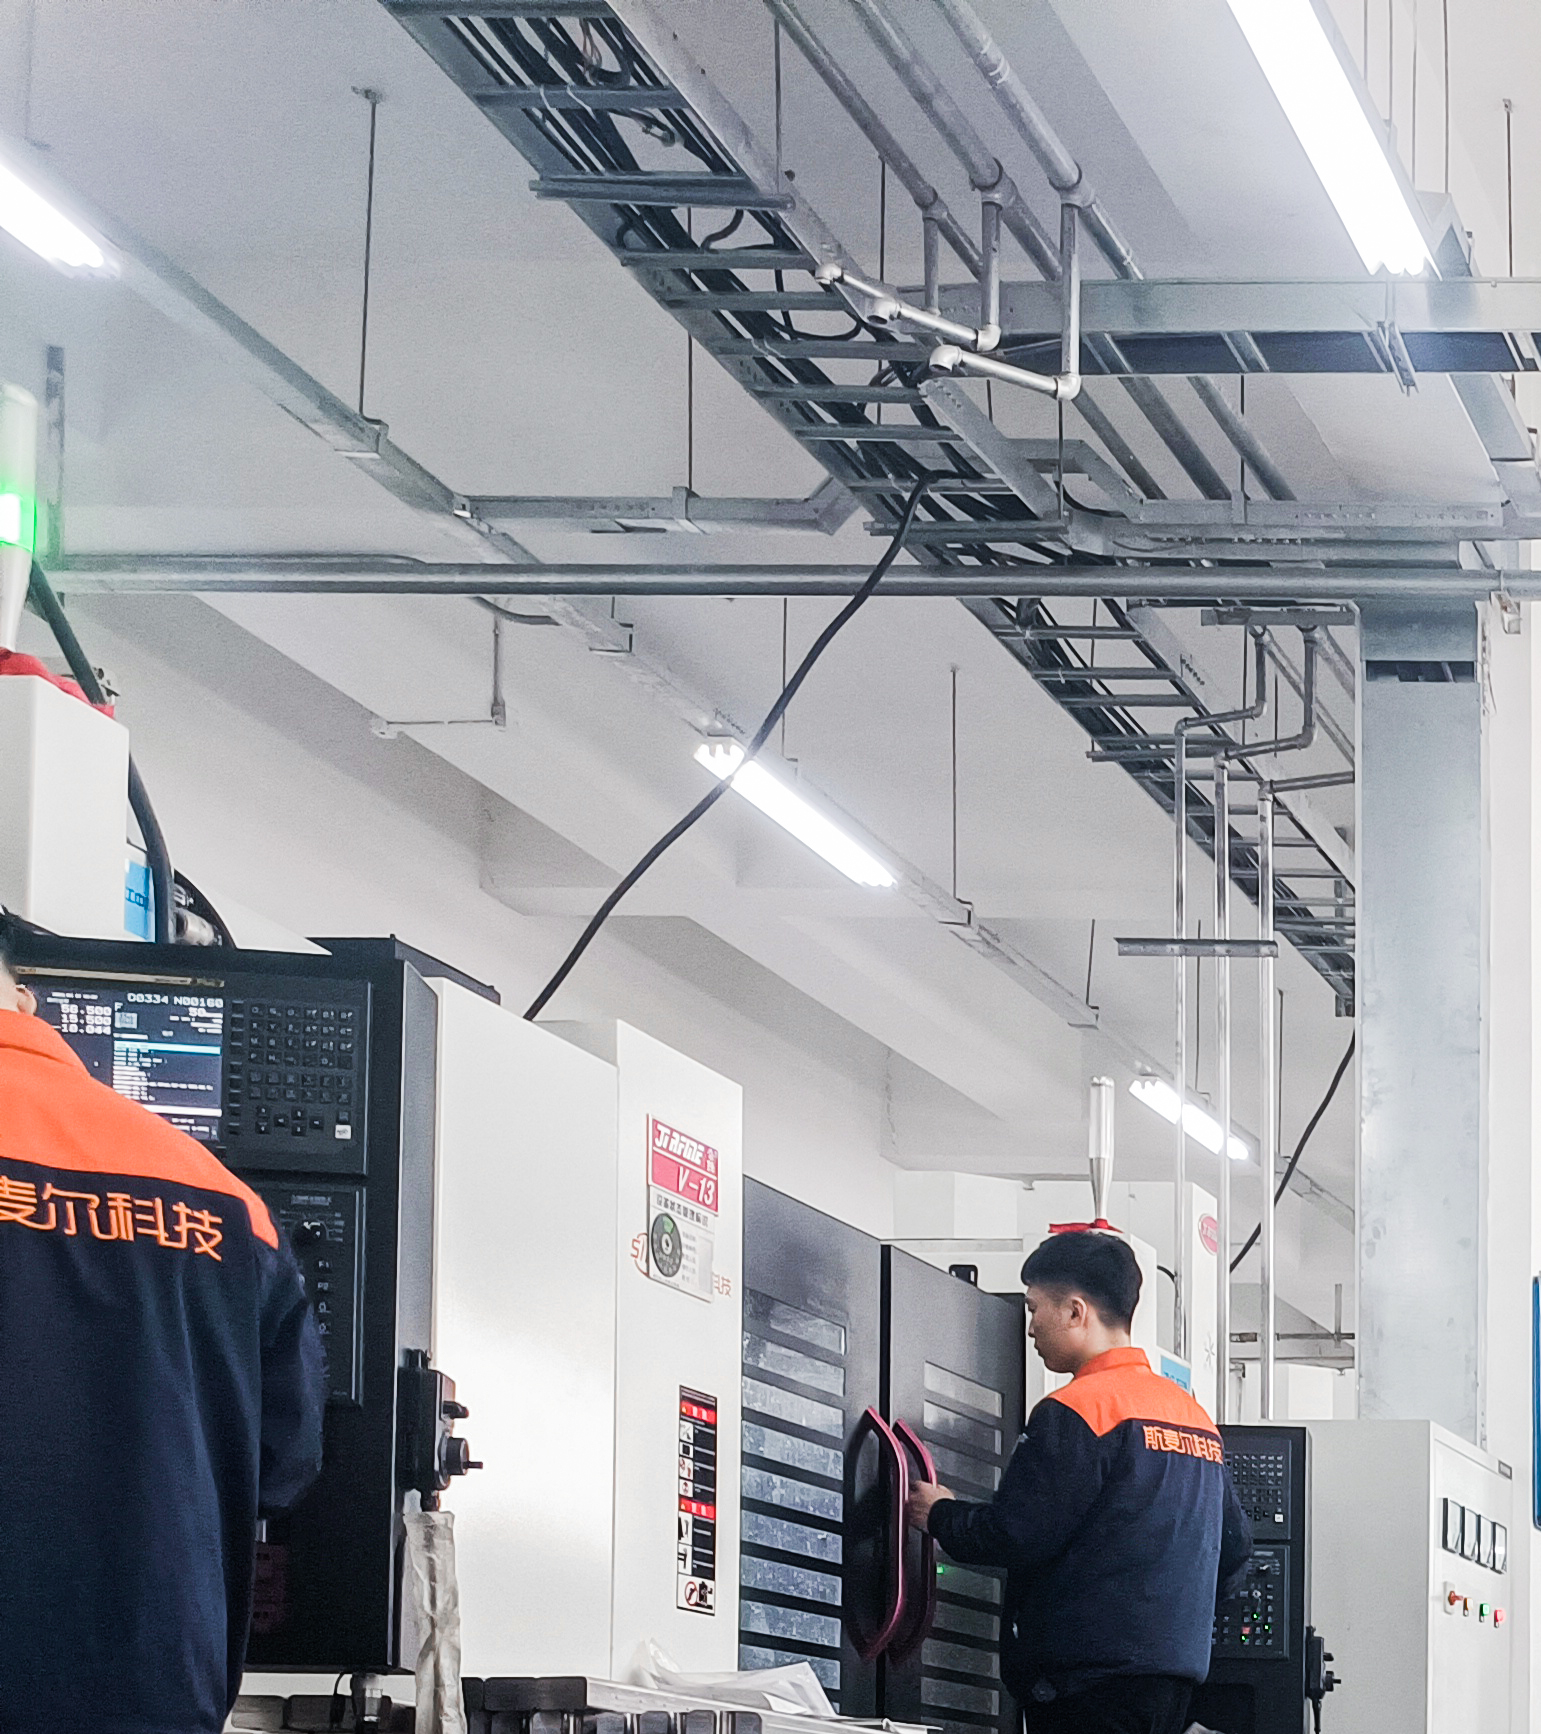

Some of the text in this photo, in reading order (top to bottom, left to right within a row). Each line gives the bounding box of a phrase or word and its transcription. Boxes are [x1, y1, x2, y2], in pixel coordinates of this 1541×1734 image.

[678, 1166, 716, 1206] V-13
[1142, 1425, 1224, 1465] 斯麦尔科技
